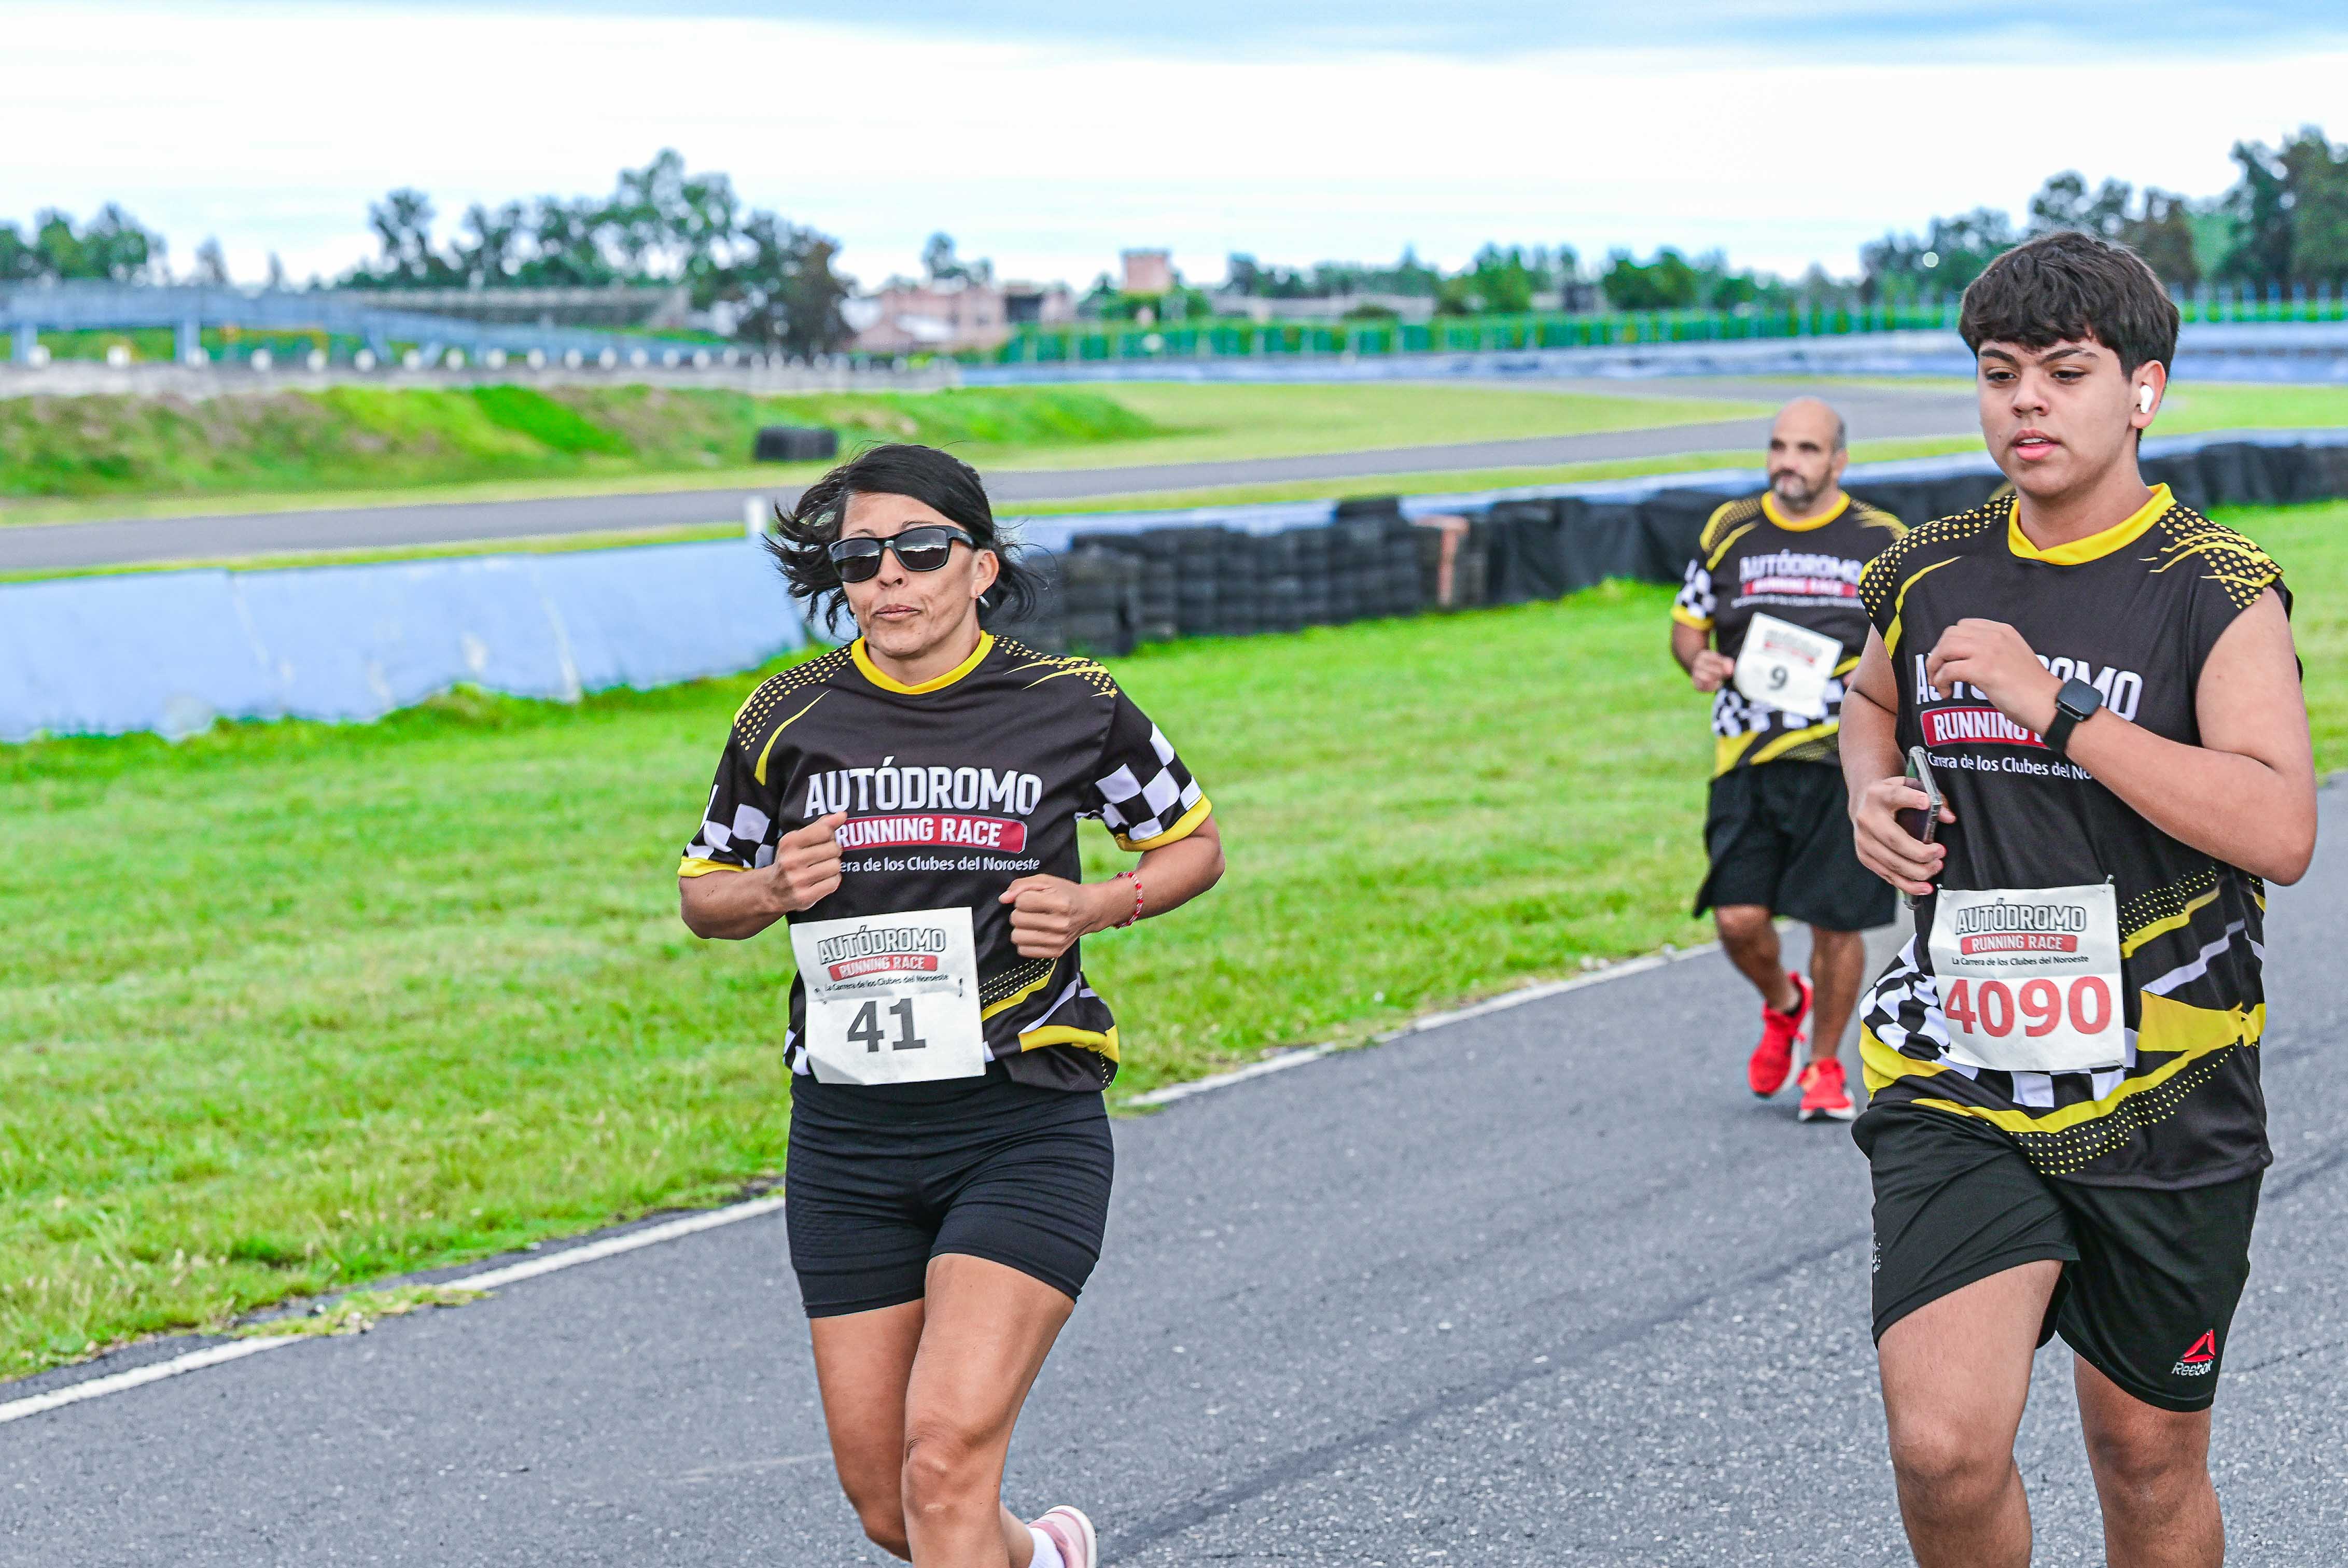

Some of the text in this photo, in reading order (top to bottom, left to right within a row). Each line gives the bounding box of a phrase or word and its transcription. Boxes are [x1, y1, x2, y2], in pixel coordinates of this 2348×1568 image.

[1769, 665, 1788, 690] 9
[1961, 754, 1974, 769] de
[1977, 755, 1999, 772] los
[2002, 757, 2048, 775] Clubes
[2051, 762, 2069, 778] del
[803, 755, 1042, 819] AUTÓDROMO
[835, 818, 1002, 847] RUNNING RACE
[863, 857, 881, 872] de
[884, 857, 904, 871] los
[906, 856, 954, 871] Clubes
[957, 856, 980, 871] del
[983, 857, 1040, 871] Noroeste
[1955, 898, 2086, 934] AUTÓDROMO
[817, 925, 946, 965] AUTÓDROMO
[1972, 935, 2063, 952] RUNNING RACE
[892, 957, 925, 970] RACE
[1945, 976, 2112, 1037] 4090
[846, 998, 927, 1053] 41
